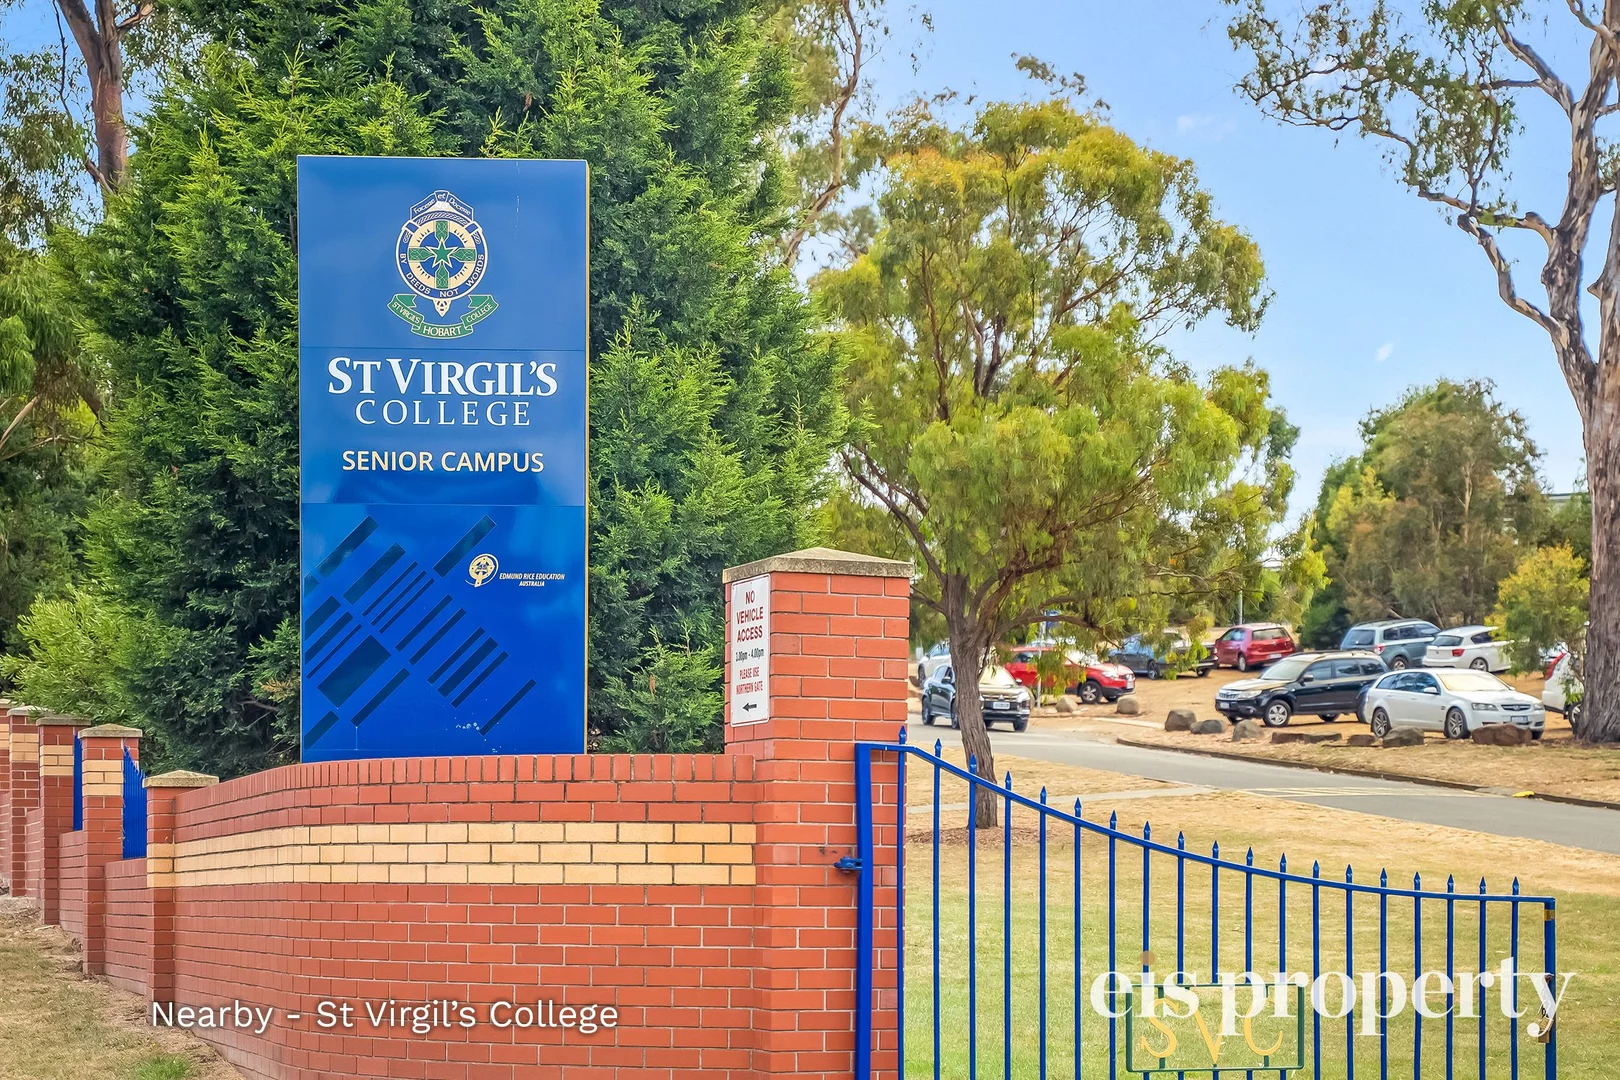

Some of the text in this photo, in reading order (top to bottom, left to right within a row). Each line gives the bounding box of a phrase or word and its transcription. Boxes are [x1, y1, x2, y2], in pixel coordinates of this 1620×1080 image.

[399, 253, 485, 298] BY DEEDS NOT WORDS
[423, 325, 462, 337] HOBART
[466, 303, 493, 323] COLLEGE
[328, 356, 558, 397] ST VIRGIL'S
[355, 399, 530, 426] COLLEGE
[342, 450, 544, 473] SENIOR CAMPUS
[499, 572, 523, 580] EDMUND
[745, 590, 756, 604] NO
[736, 606, 764, 625] VEHICLE
[736, 625, 763, 643] ACCESS
[739, 666, 760, 680] PLEASE USE
[754, 680, 763, 692] GATE
